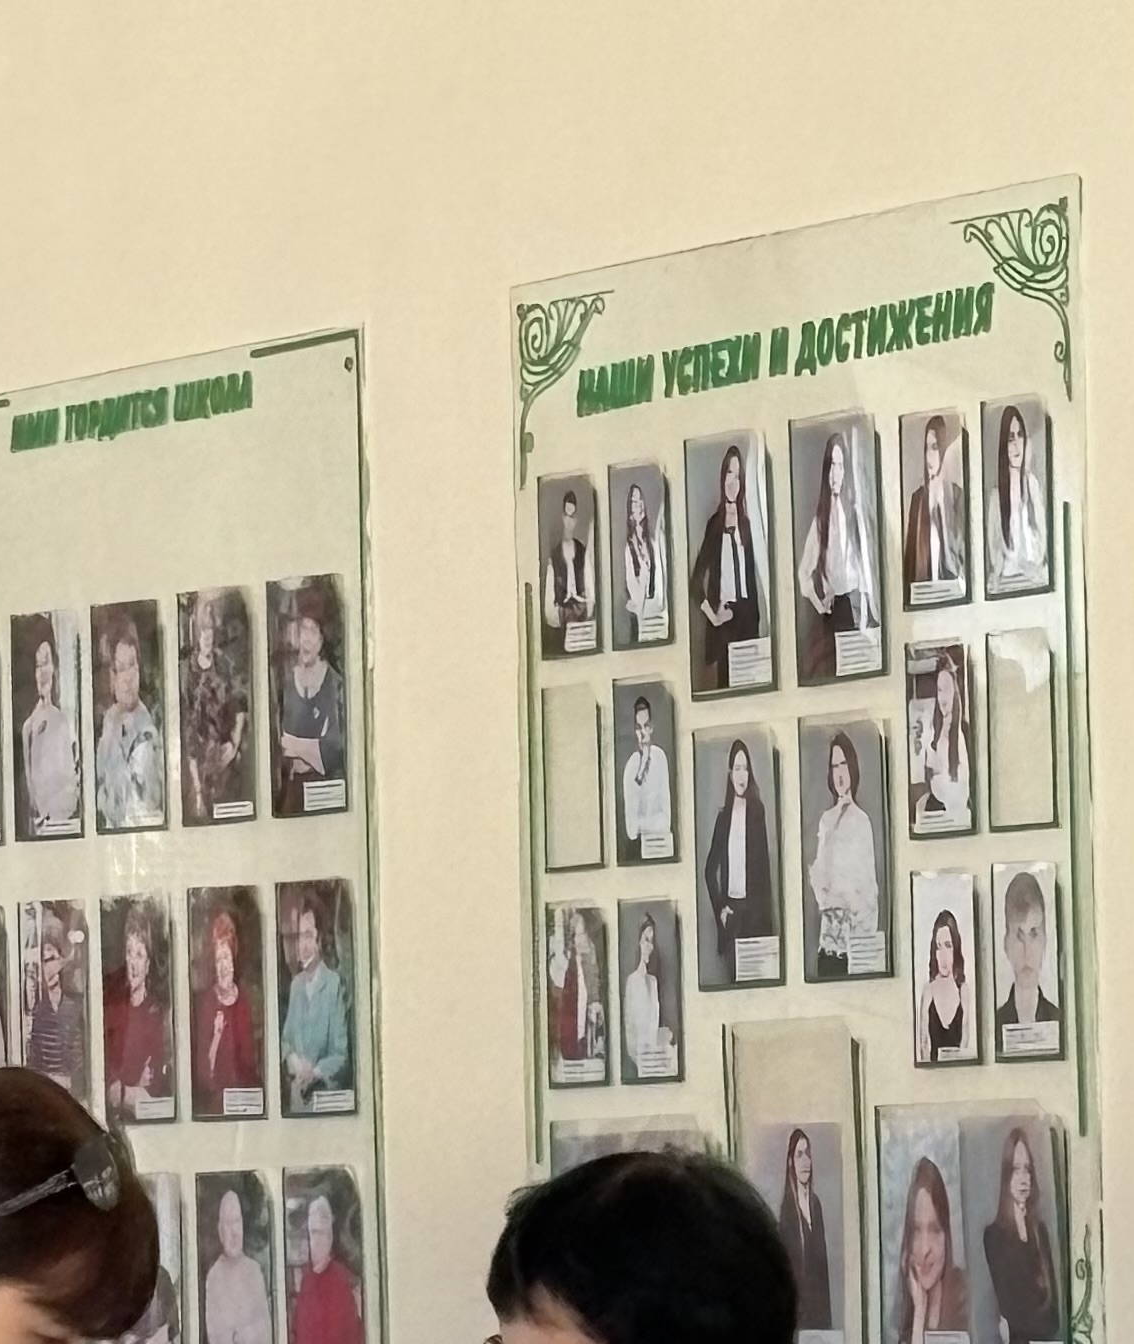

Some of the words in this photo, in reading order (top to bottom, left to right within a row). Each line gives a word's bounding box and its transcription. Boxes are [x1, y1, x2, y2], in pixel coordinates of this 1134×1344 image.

[576, 353, 655, 418] НАШИ
[662, 332, 761, 398] УСПЕХИ
[769, 326, 790, 377] И
[794, 281, 996, 377] ДОСТИЖЕНИЯ
